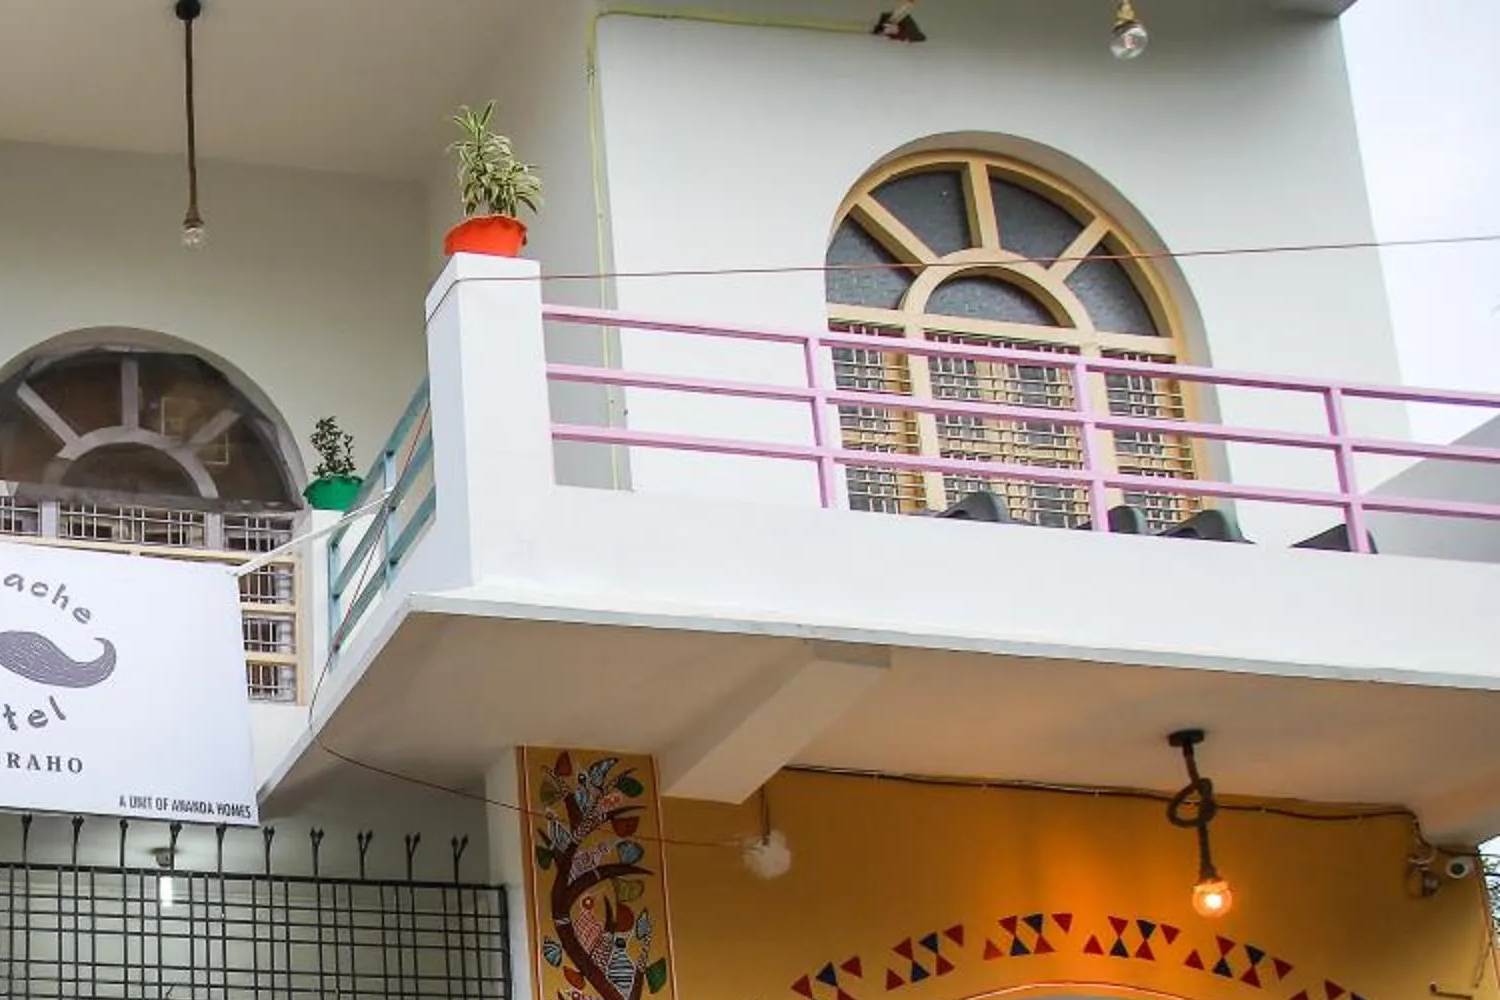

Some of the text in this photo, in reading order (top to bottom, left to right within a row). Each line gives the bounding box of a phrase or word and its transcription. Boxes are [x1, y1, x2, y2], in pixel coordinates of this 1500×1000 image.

[119, 794, 127, 808] A
[129, 795, 152, 809] UNIT
[155, 797, 169, 811] OF
[216, 802, 251, 819] HOMES
